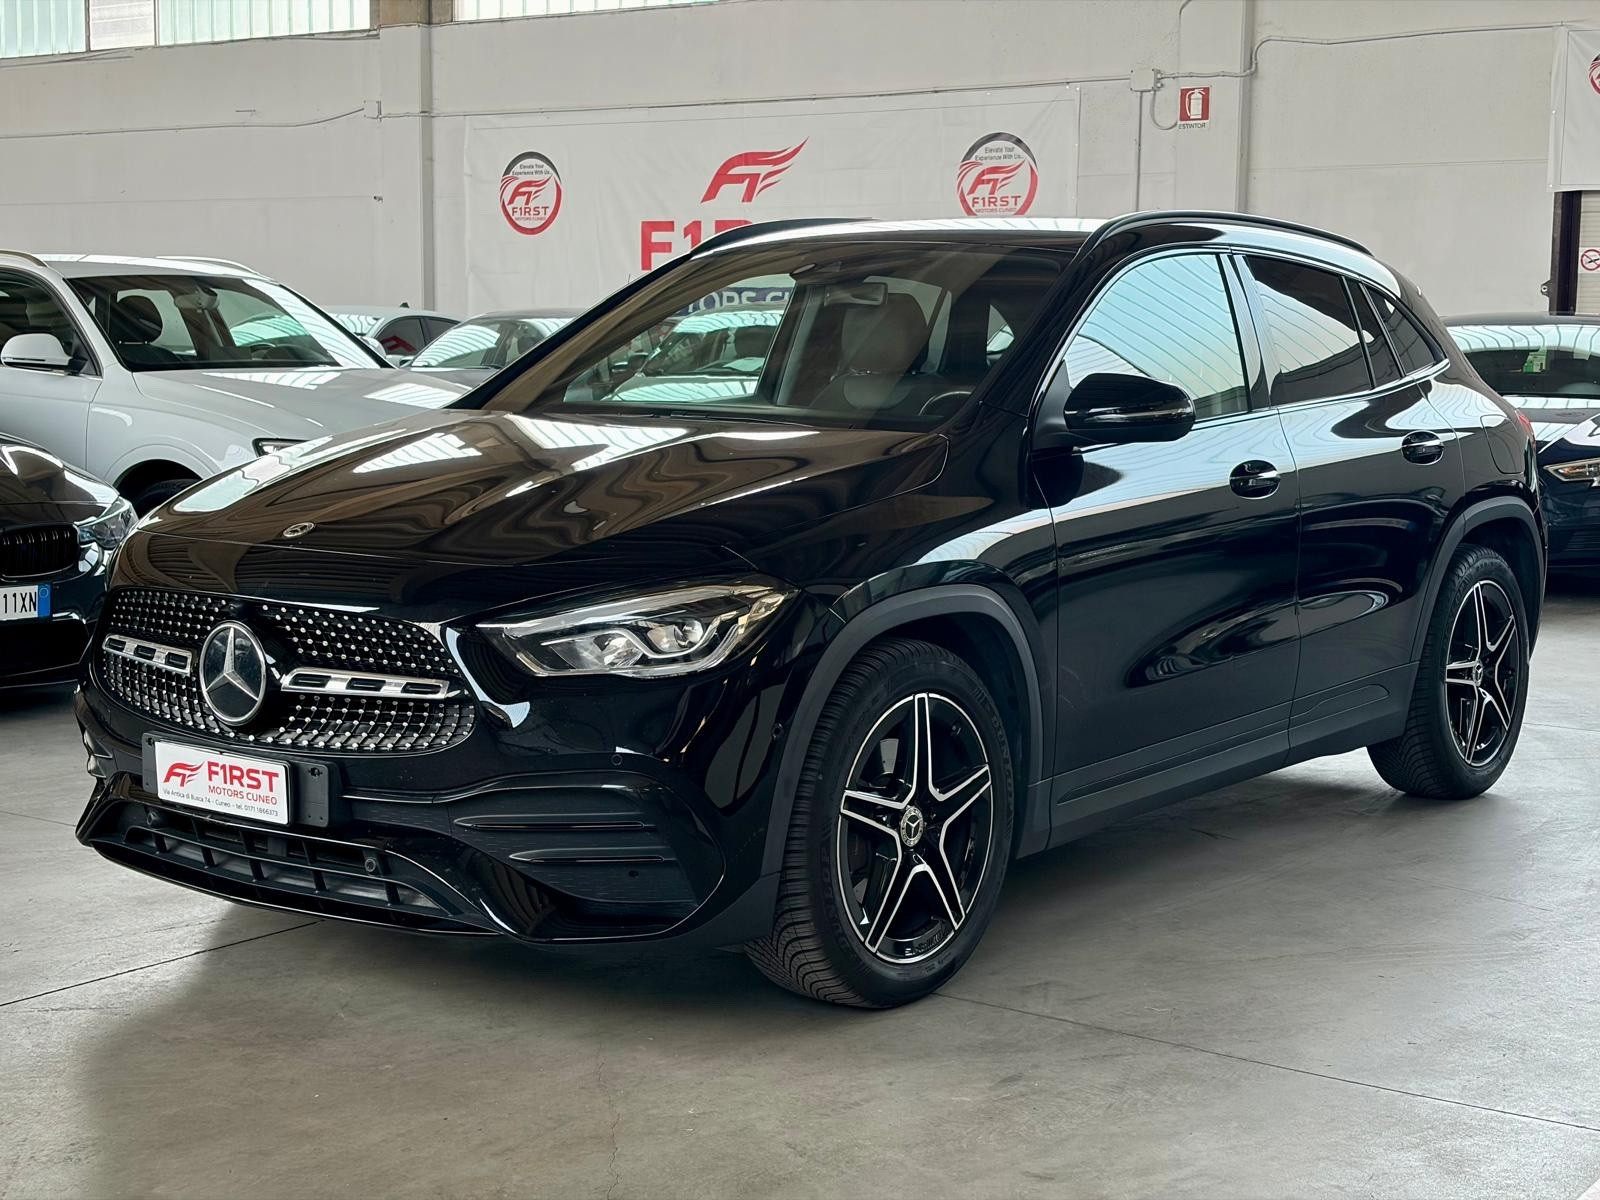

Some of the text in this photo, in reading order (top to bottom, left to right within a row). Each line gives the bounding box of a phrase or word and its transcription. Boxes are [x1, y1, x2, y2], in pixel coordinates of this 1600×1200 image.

[972, 195, 1021, 207] F1RST
[511, 206, 549, 216] F1RST
[207, 761, 279, 792] F1RST
[171, 790, 184, 798] Antica
[191, 794, 204, 802] Busca
[215, 799, 231, 807] Cuneo
[208, 785, 278, 806] MOTORS CUNEO
